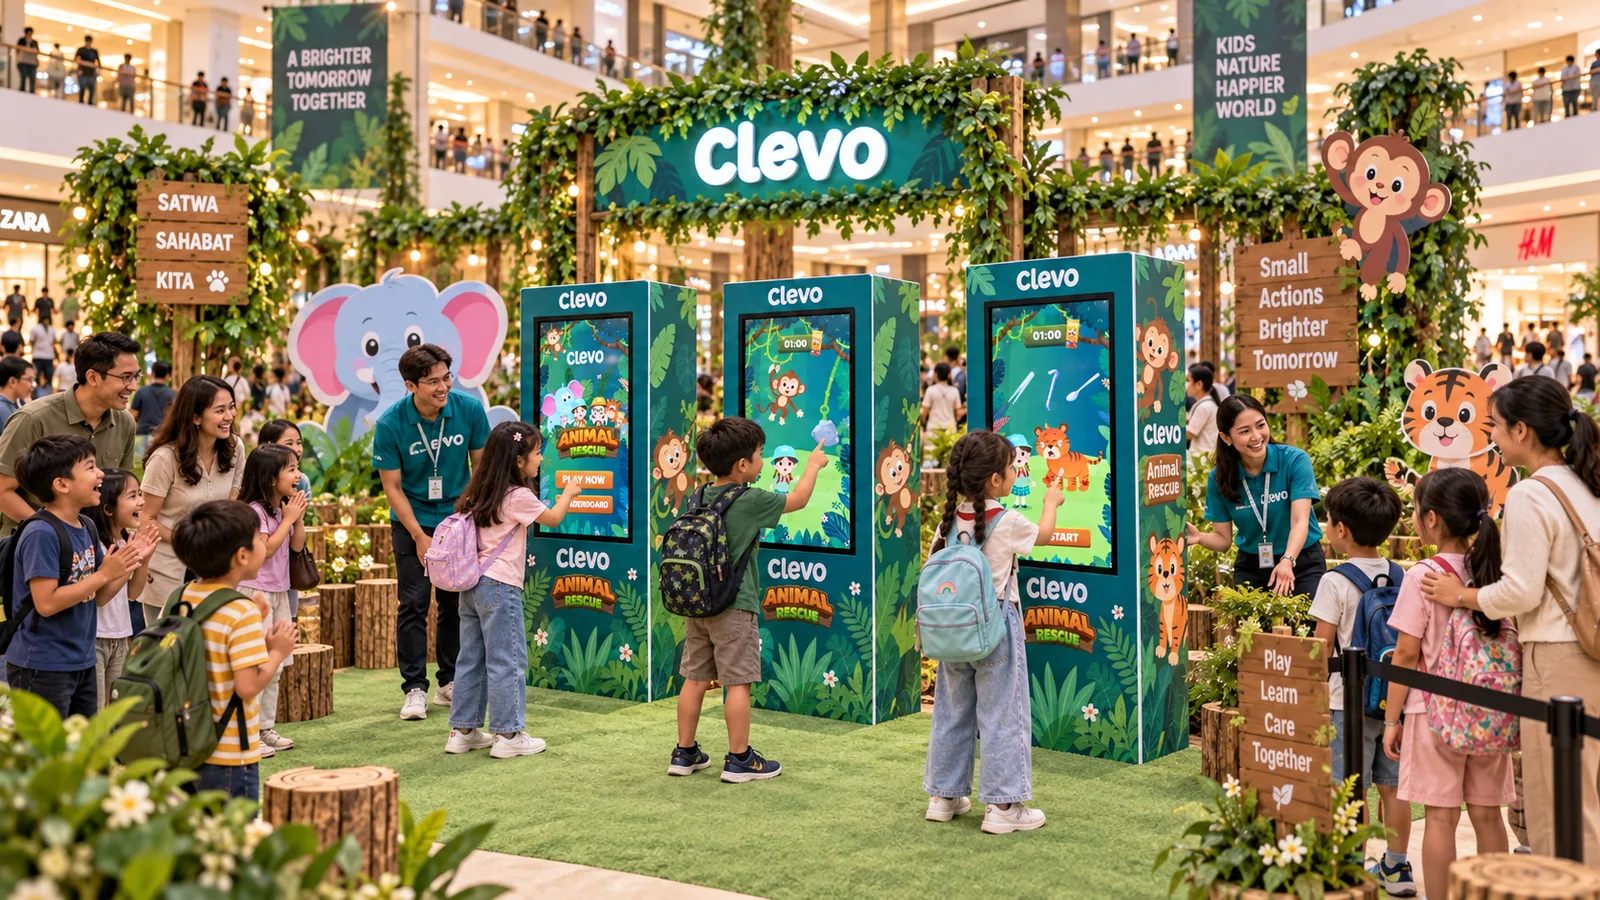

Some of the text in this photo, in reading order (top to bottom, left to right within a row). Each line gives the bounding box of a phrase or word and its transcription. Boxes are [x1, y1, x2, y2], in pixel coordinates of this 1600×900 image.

[1216, 34, 1256, 55] KIDS
[287, 46, 371, 68] A BRIGHTER
[1216, 53, 1281, 76] NATURE
[286, 69, 372, 89] TOMORROW
[1216, 75, 1285, 98] HAPPIER
[291, 91, 366, 111] TOGETHER
[1216, 98, 1277, 119] WORLD
[694, 121, 888, 186] Clevo
[158, 193, 219, 213] SATWA
[0, 208, 51, 234] ZARA
[155, 231, 234, 251] SAHABAT
[1260, 252, 1309, 278] Small
[156, 271, 195, 290] KITA
[1016, 268, 1079, 291] Clevo
[558, 290, 608, 310] Clevo
[767, 285, 823, 306] Clevo
[1259, 284, 1324, 309] Actions
[1032, 329, 1062, 341] 01:00
[1259, 316, 1329, 344] Brighter
[784, 339, 808, 348] 01:00
[1253, 349, 1338, 371] Tomorrow
[557, 428, 619, 449] ANIMAL
[1143, 422, 1182, 446] Clevo
[569, 445, 607, 458] RESCUE
[1147, 459, 1180, 480] Animal
[1148, 481, 1180, 500] Rescue
[1050, 532, 1079, 543] START
[556, 547, 610, 571] Clevo
[767, 557, 827, 582] Clevo
[552, 575, 616, 603] ANIMAL
[1026, 576, 1088, 604] Clevo
[564, 594, 603, 610] RESCUE
[763, 586, 834, 615] ANIMAL
[775, 606, 820, 623] RESCUE
[1024, 607, 1096, 639] ANIMAL
[1035, 628, 1080, 647] RESCUE
[1264, 649, 1292, 676] Play
[1260, 680, 1298, 705] Learn
[1264, 712, 1295, 736] Care
[1252, 741, 1313, 773] Together
